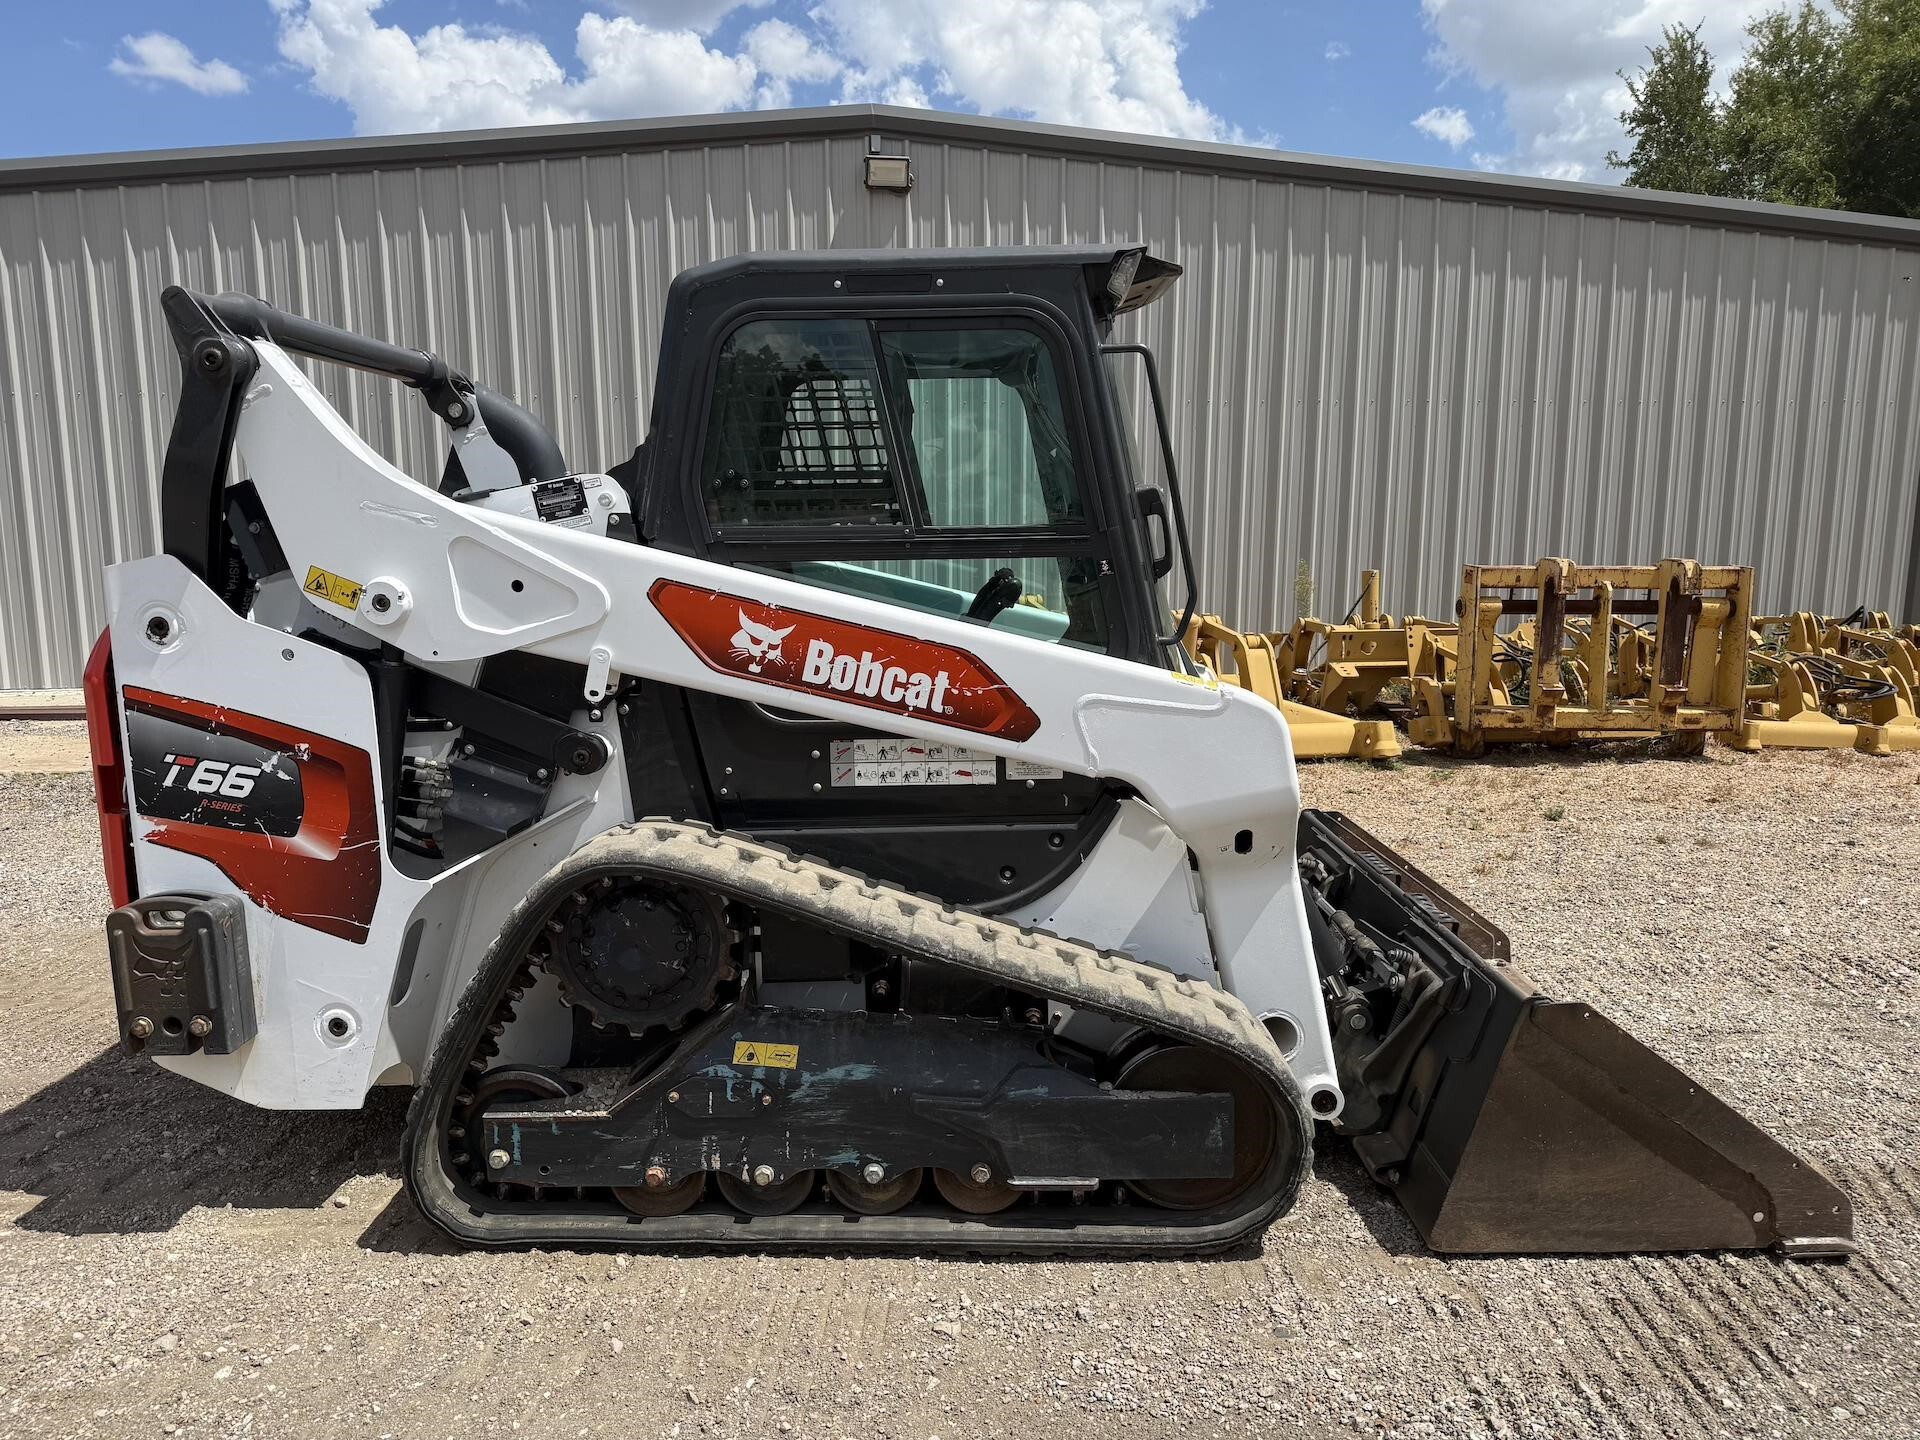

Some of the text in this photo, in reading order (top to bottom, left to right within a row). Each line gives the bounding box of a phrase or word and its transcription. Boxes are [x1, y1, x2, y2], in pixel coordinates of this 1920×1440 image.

[802, 638, 949, 713] Bobcat
[162, 753, 262, 798] T66
[200, 799, 243, 813] R-SERIES
